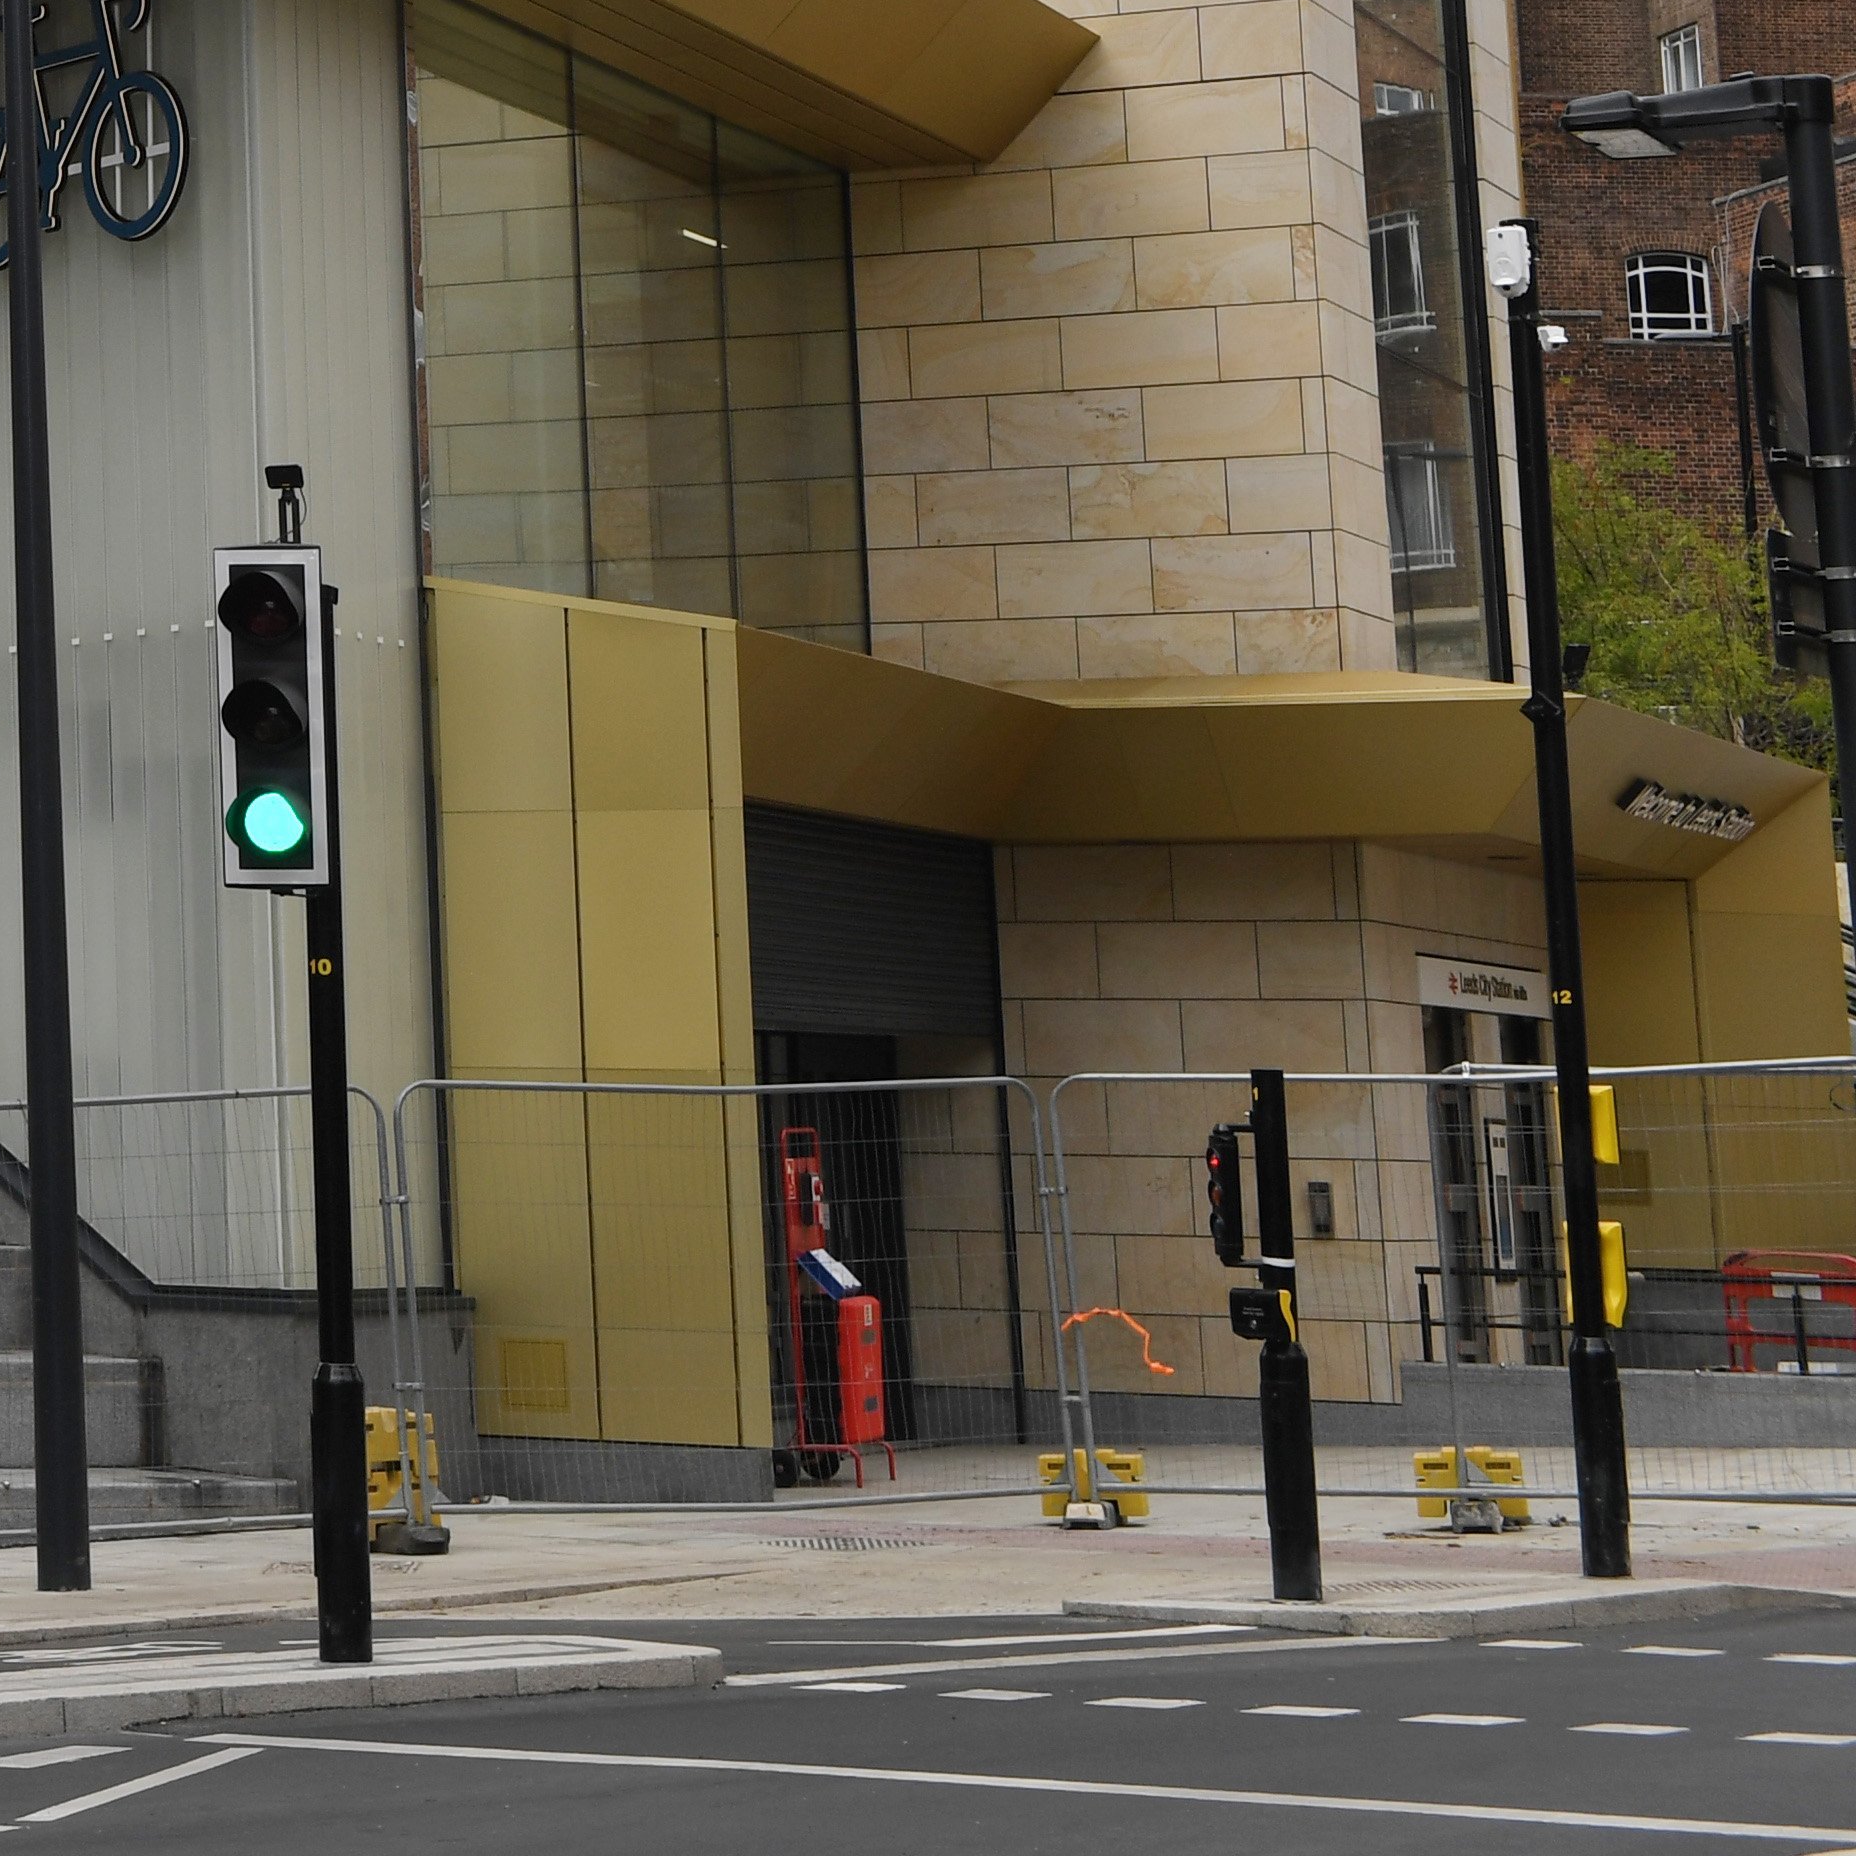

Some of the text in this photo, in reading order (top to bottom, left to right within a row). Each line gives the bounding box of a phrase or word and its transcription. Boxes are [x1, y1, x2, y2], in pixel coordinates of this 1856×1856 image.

[1682, 802, 1726, 835] Leeds
[1711, 808, 1756, 841] Station
[309, 958, 332, 975] 10
[1459, 972, 1479, 995] Leeds
[1478, 974, 1491, 1002] City
[1491, 975, 1513, 999] Station
[1552, 990, 1573, 1004] 12
